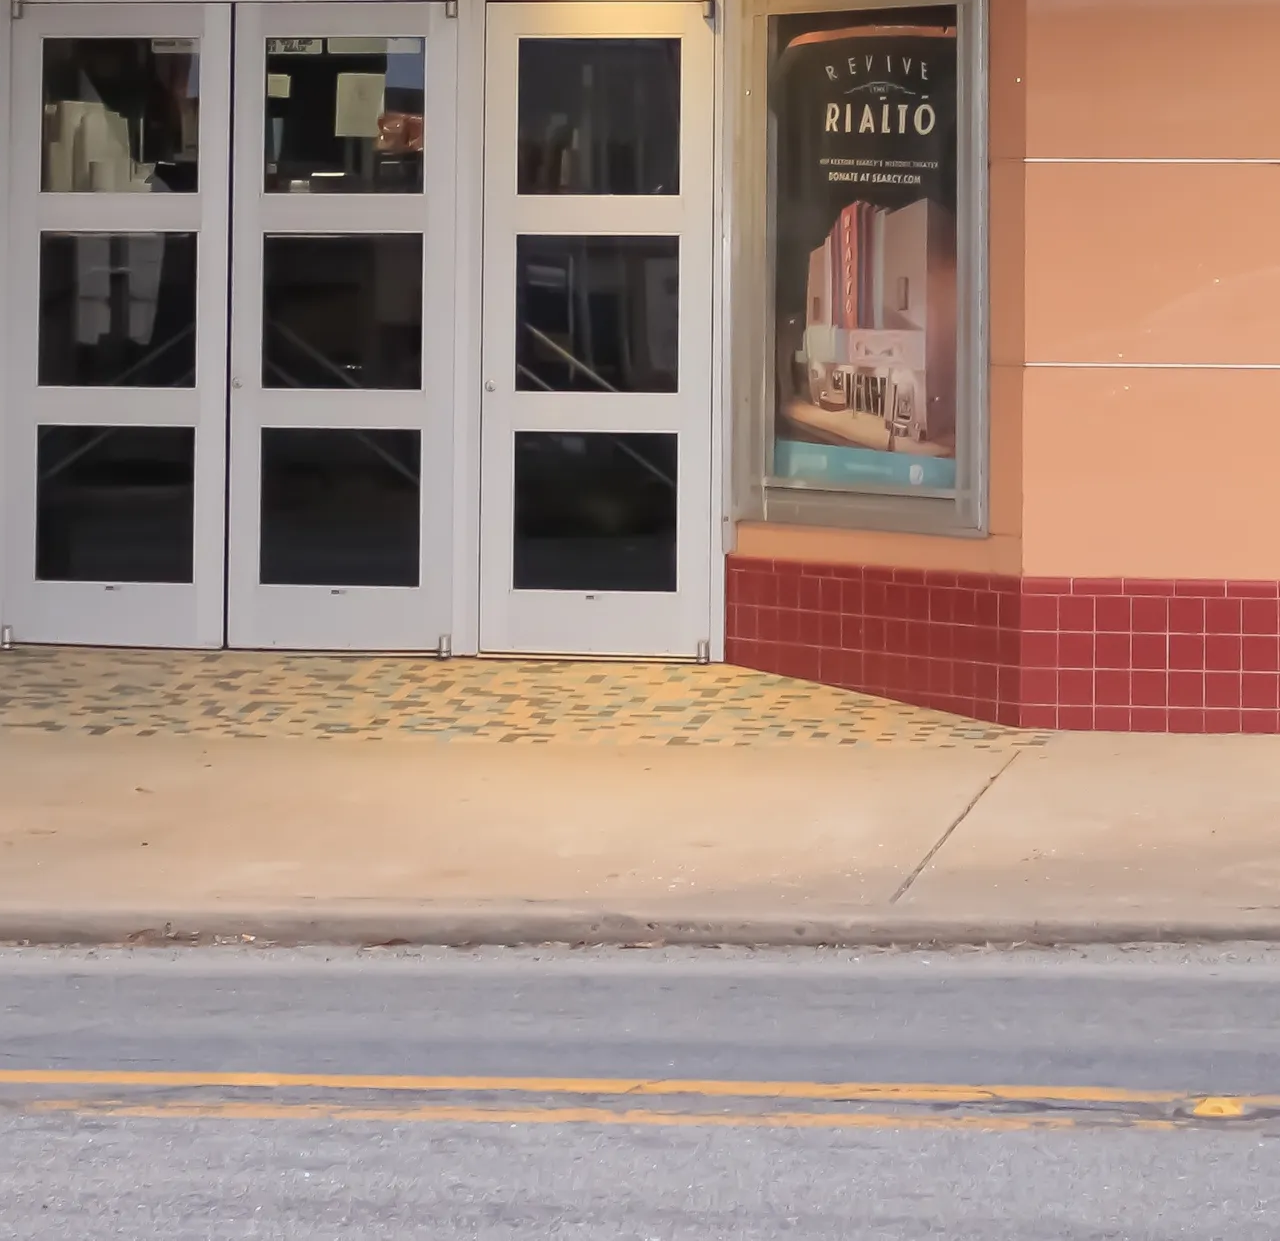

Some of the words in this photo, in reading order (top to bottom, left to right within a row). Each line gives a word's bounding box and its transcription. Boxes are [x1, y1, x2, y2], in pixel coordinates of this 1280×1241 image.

[825, 54, 929, 81] REVIVE
[825, 102, 936, 136] RIALTO
[828, 171, 859, 182] DONATE
[860, 172, 870, 182] AT
[872, 173, 921, 184] SEARCY.COM
